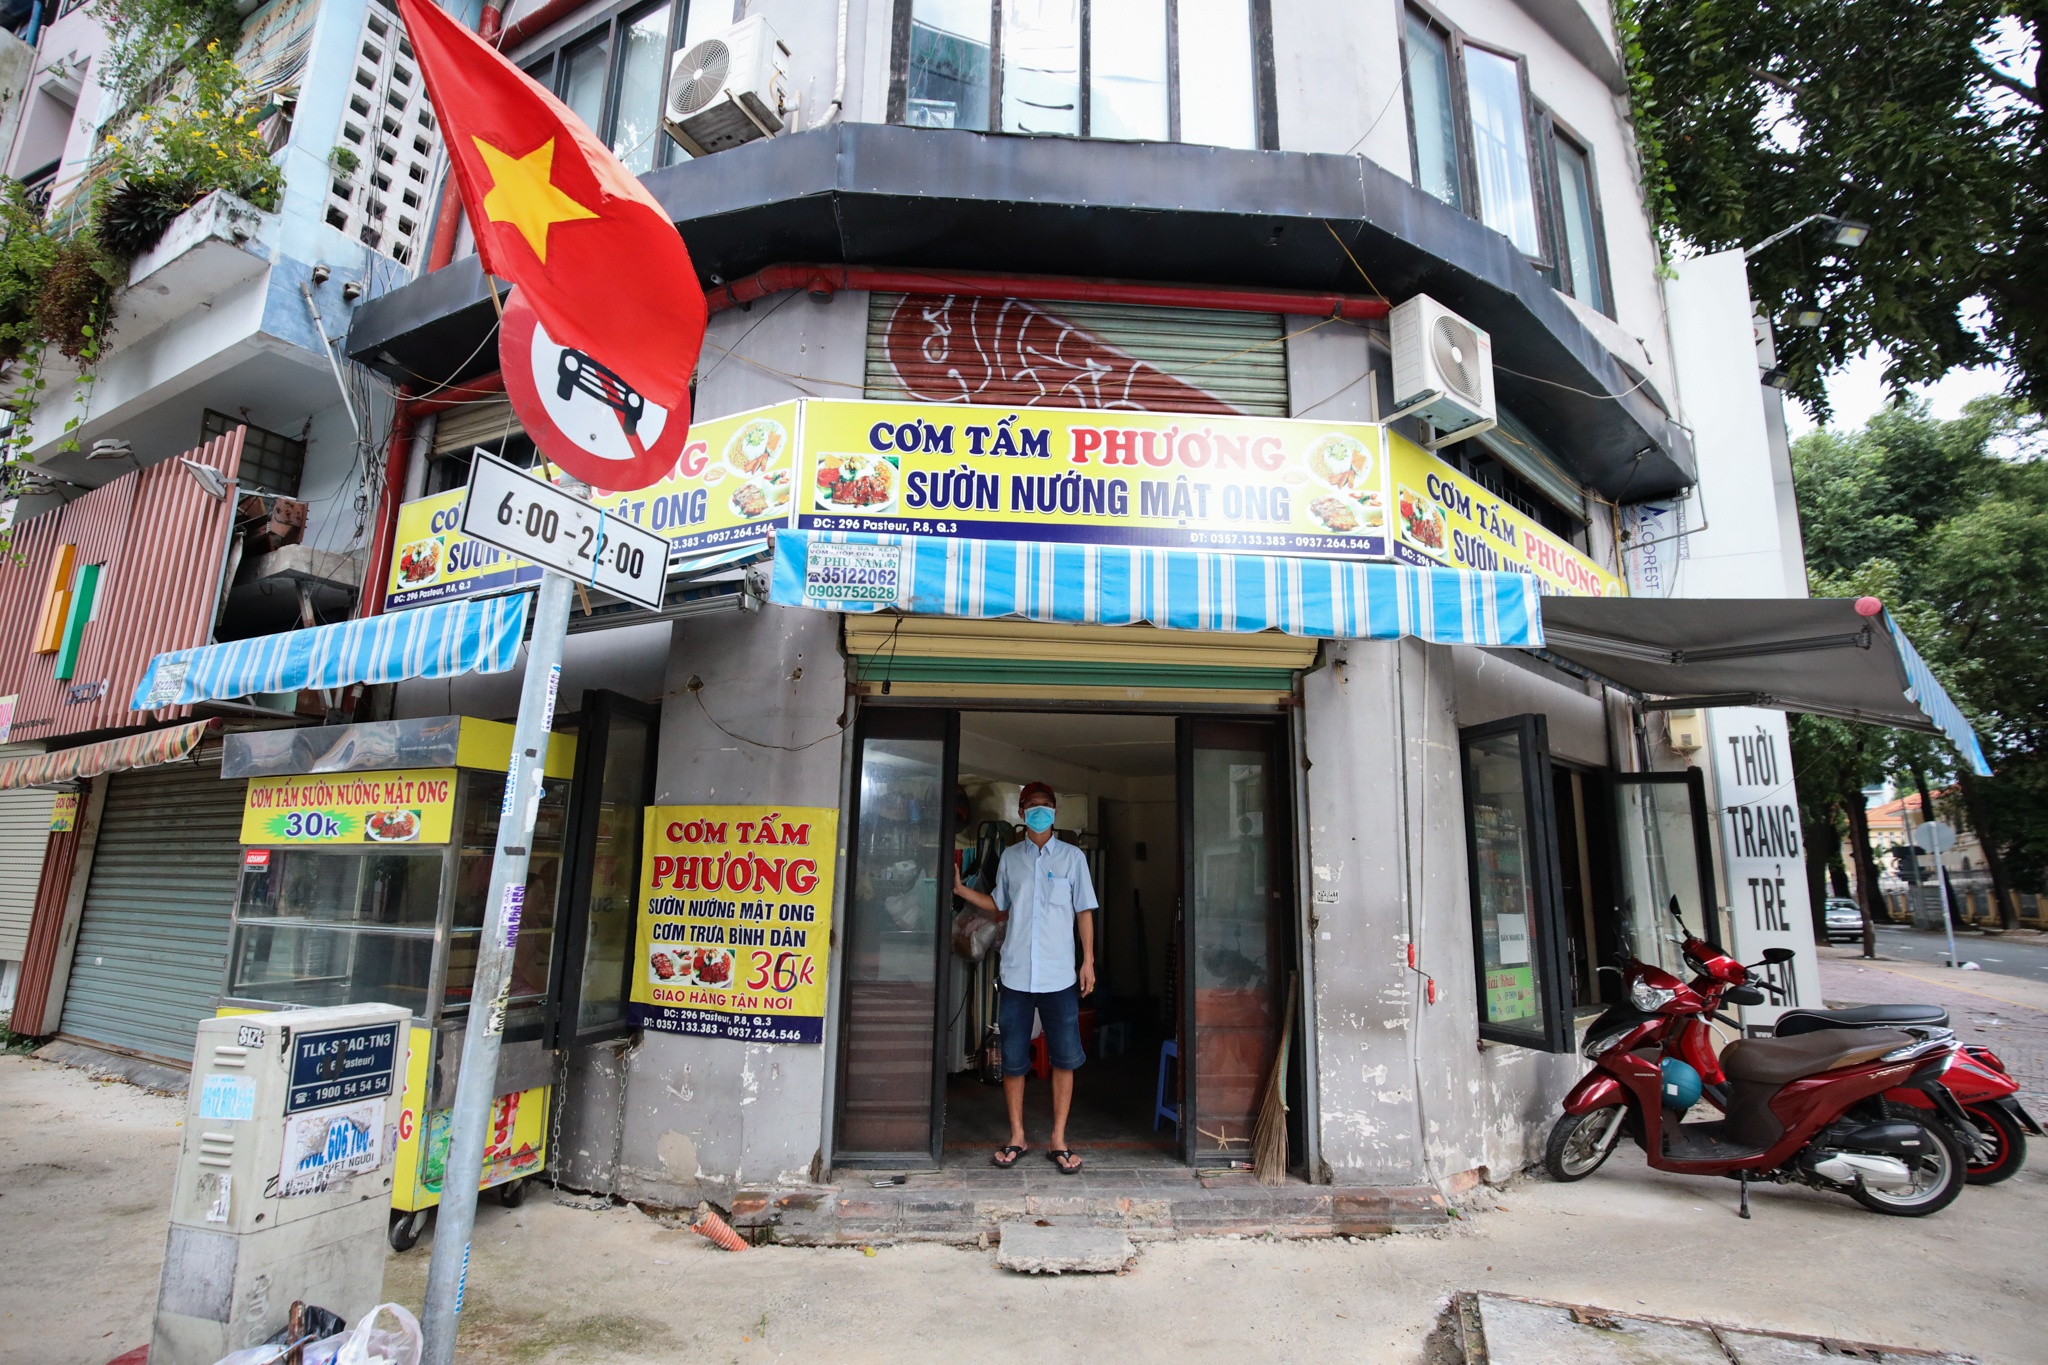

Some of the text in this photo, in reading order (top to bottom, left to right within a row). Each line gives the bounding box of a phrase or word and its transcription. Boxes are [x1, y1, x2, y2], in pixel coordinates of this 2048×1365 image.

[868, 414, 1286, 471] CƠM TẤM PHƯƠNG
[651, 489, 708, 531] ONG
[906, 465, 1291, 526] SƯỜN NƯỚNG MẬT ONG
[431, 501, 462, 533] CƠ
[813, 518, 958, 534] ĐC: 296 Pasteur, P.8, Q.3
[1190, 533, 1208, 544] ĐT:
[1210, 534, 1286, 546] 0357.133.383
[1295, 537, 1371, 550] 0937.264.546
[1427, 473, 1472, 521] CƠM
[1522, 529, 1602, 597] PHƯƠNG
[1453, 529, 1498, 571] SƯỜN
[821, 567, 897, 586] 35122062
[854, 557, 882, 569] NAM
[808, 585, 895, 600] 0903752628
[1728, 724, 1780, 786] THỜI
[250, 776, 449, 811] CƠM TẤM SƯỜN NƯỚNG MẬT ONG
[285, 812, 340, 837] 30k
[666, 812, 811, 846] CƠM TẤM
[1727, 804, 1800, 858] TRANG
[651, 850, 819, 895] PHƯƠNG
[648, 895, 815, 925] SƯỜN NƯỚNG MẬT ONG
[1748, 864, 1791, 932] TRẺ
[653, 923, 807, 948] CƠM TRƯA BÌNH DÂN
[653, 989, 793, 1012] GIAO HÀNG TẬN NƠI
[643, 1017, 655, 1028] ĐT:
[656, 1019, 718, 1034] 0357.133.383
[727, 1028, 801, 1041] 0937.264.546
[663, 1009, 772, 1027] ĐC: 296 Pasteur, P.8, Q.3
[316, 1077, 387, 1101] 1900 54 54 54
